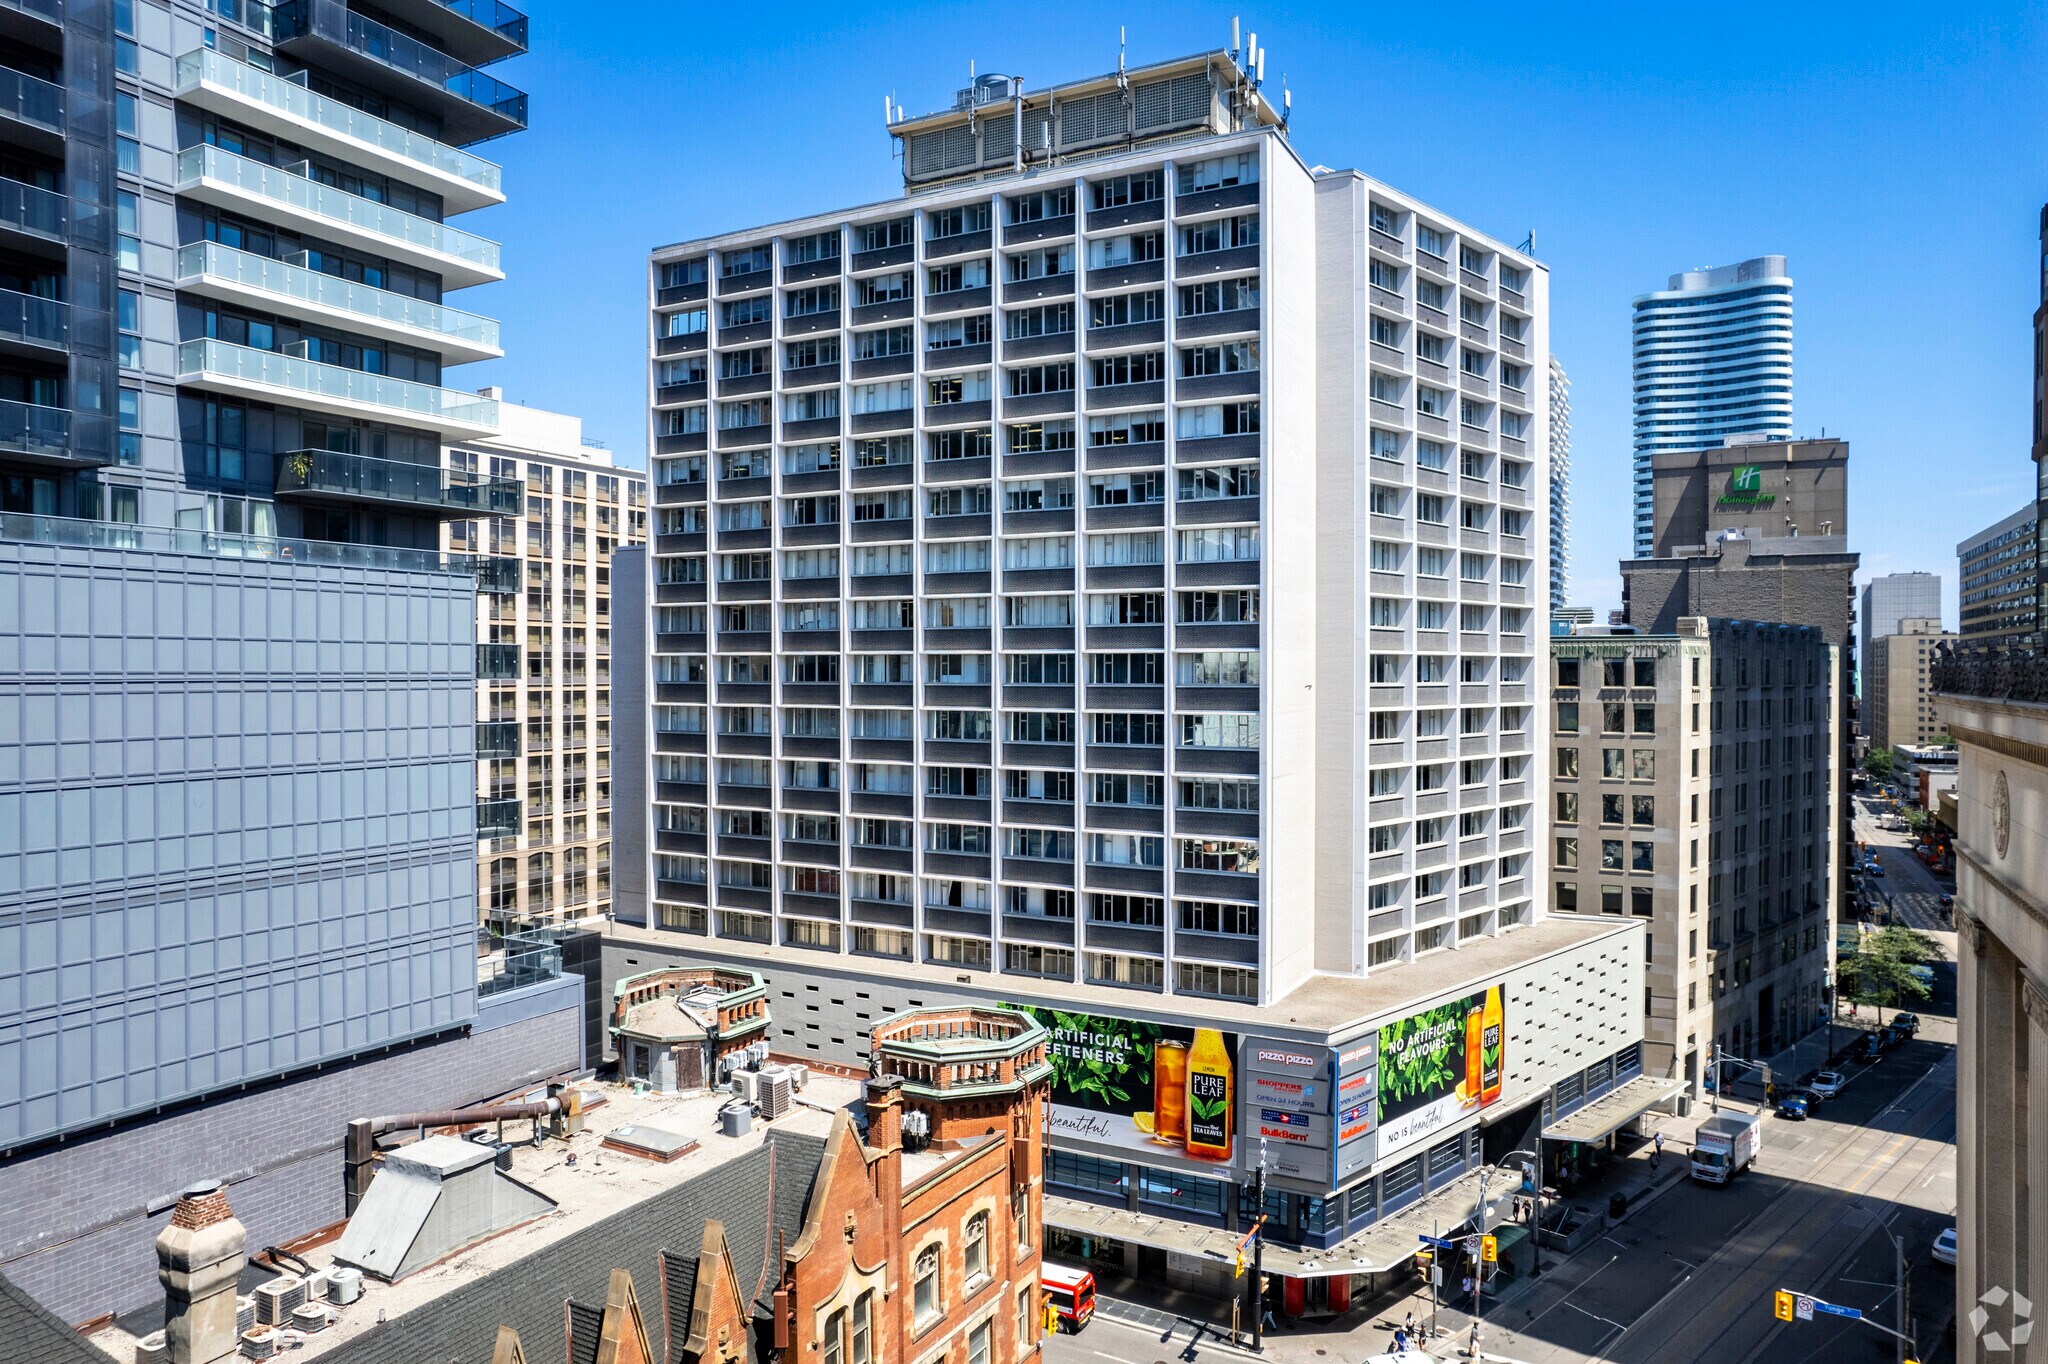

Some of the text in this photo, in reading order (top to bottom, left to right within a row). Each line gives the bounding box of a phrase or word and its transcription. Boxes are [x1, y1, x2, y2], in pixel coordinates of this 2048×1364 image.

[1716, 494, 1757, 505] Holiday
[1044, 1026, 1132, 1050] ARTIFICIAL
[1389, 1018, 1457, 1055] NO ARTIFICIAL
[1484, 1025, 1499, 1037] PURE
[1484, 1034, 1499, 1048] LEAF
[1045, 1041, 1124, 1065] EETENERS
[1400, 1036, 1447, 1065] FLAVOURS
[1258, 1050, 1314, 1066] pizza pizza
[1193, 1074, 1224, 1088] PURE
[1257, 1079, 1302, 1090] SHOPPERS
[1193, 1083, 1224, 1098] LEAF
[1256, 1094, 1277, 1102] OPEN
[1289, 1099, 1315, 1108] HOURS
[1388, 1131, 1399, 1144] NO
[1401, 1126, 1408, 1137] IS
[1824, 1304, 1845, 1315] Yonge
